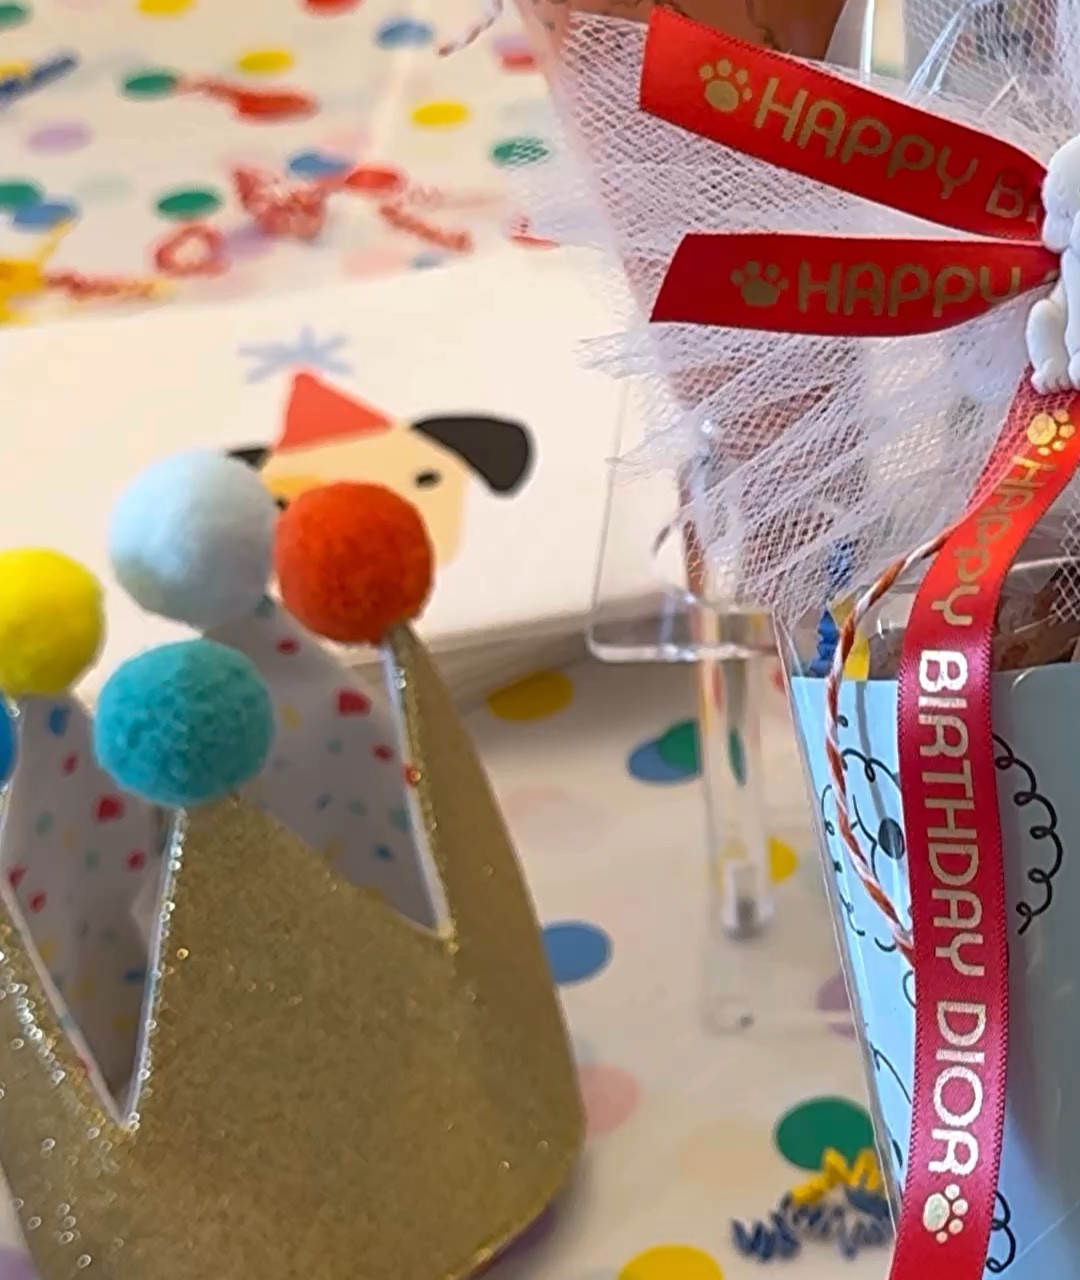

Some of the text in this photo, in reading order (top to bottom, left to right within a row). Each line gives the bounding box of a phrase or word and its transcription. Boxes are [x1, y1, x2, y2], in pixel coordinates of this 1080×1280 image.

[753, 76, 980, 200] HAPPY
[918, 454, 1057, 1176] HAPPY BIRTHDAY DIOR
